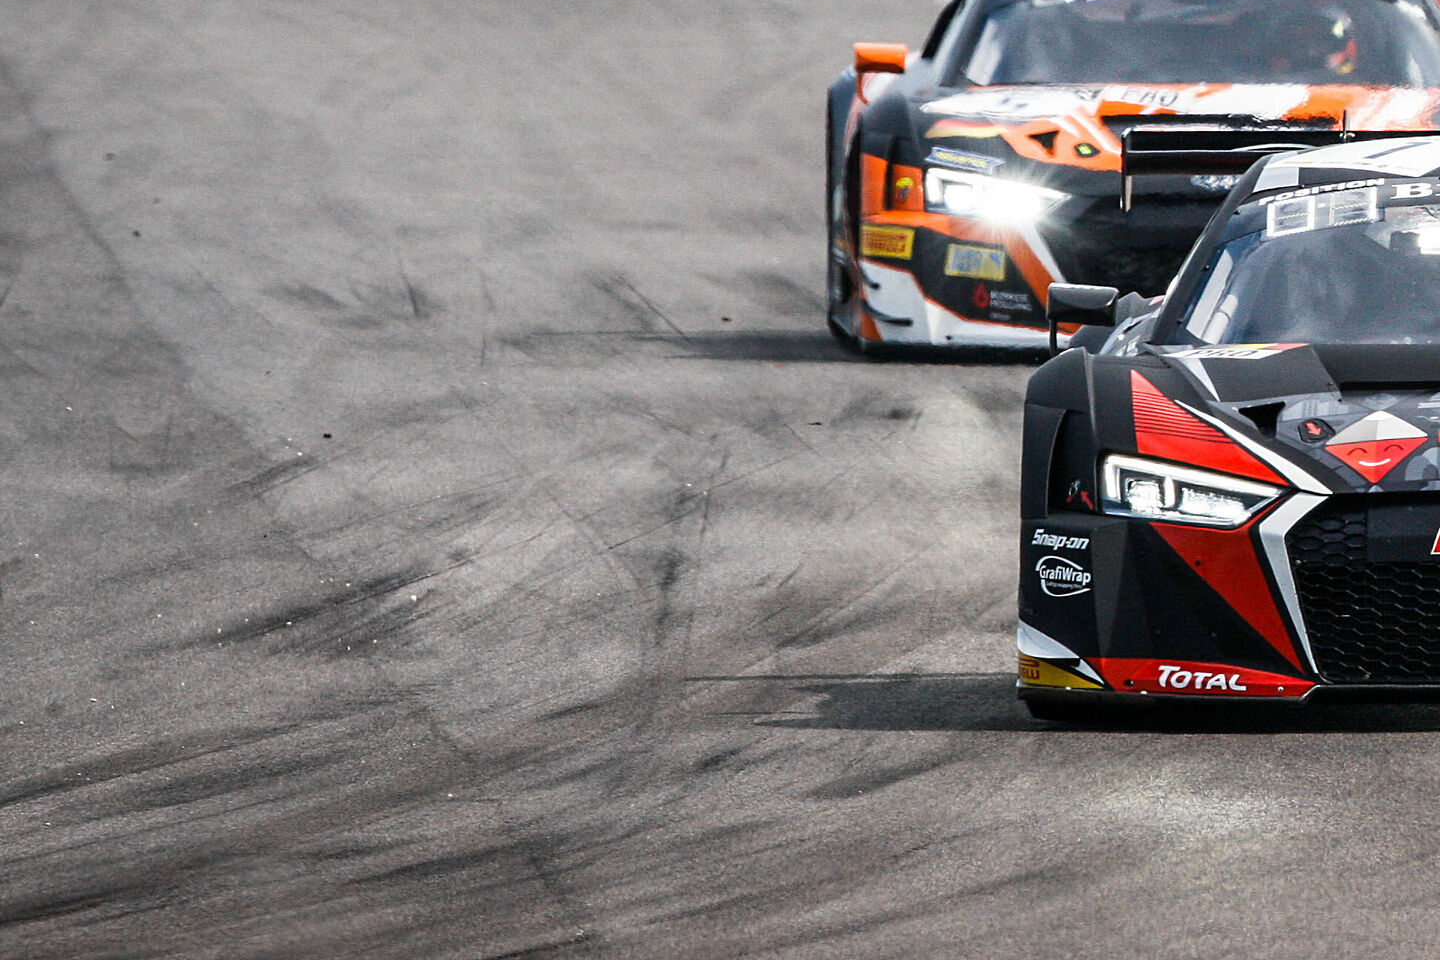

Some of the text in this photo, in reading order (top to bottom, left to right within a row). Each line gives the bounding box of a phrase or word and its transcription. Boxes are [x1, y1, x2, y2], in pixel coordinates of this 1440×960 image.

[1258, 178, 1385, 206] POSITION
[1031, 528, 1090, 550] Snap-on
[1039, 564, 1092, 587] GrafiWrap
[1158, 665, 1247, 691] TOTAL
